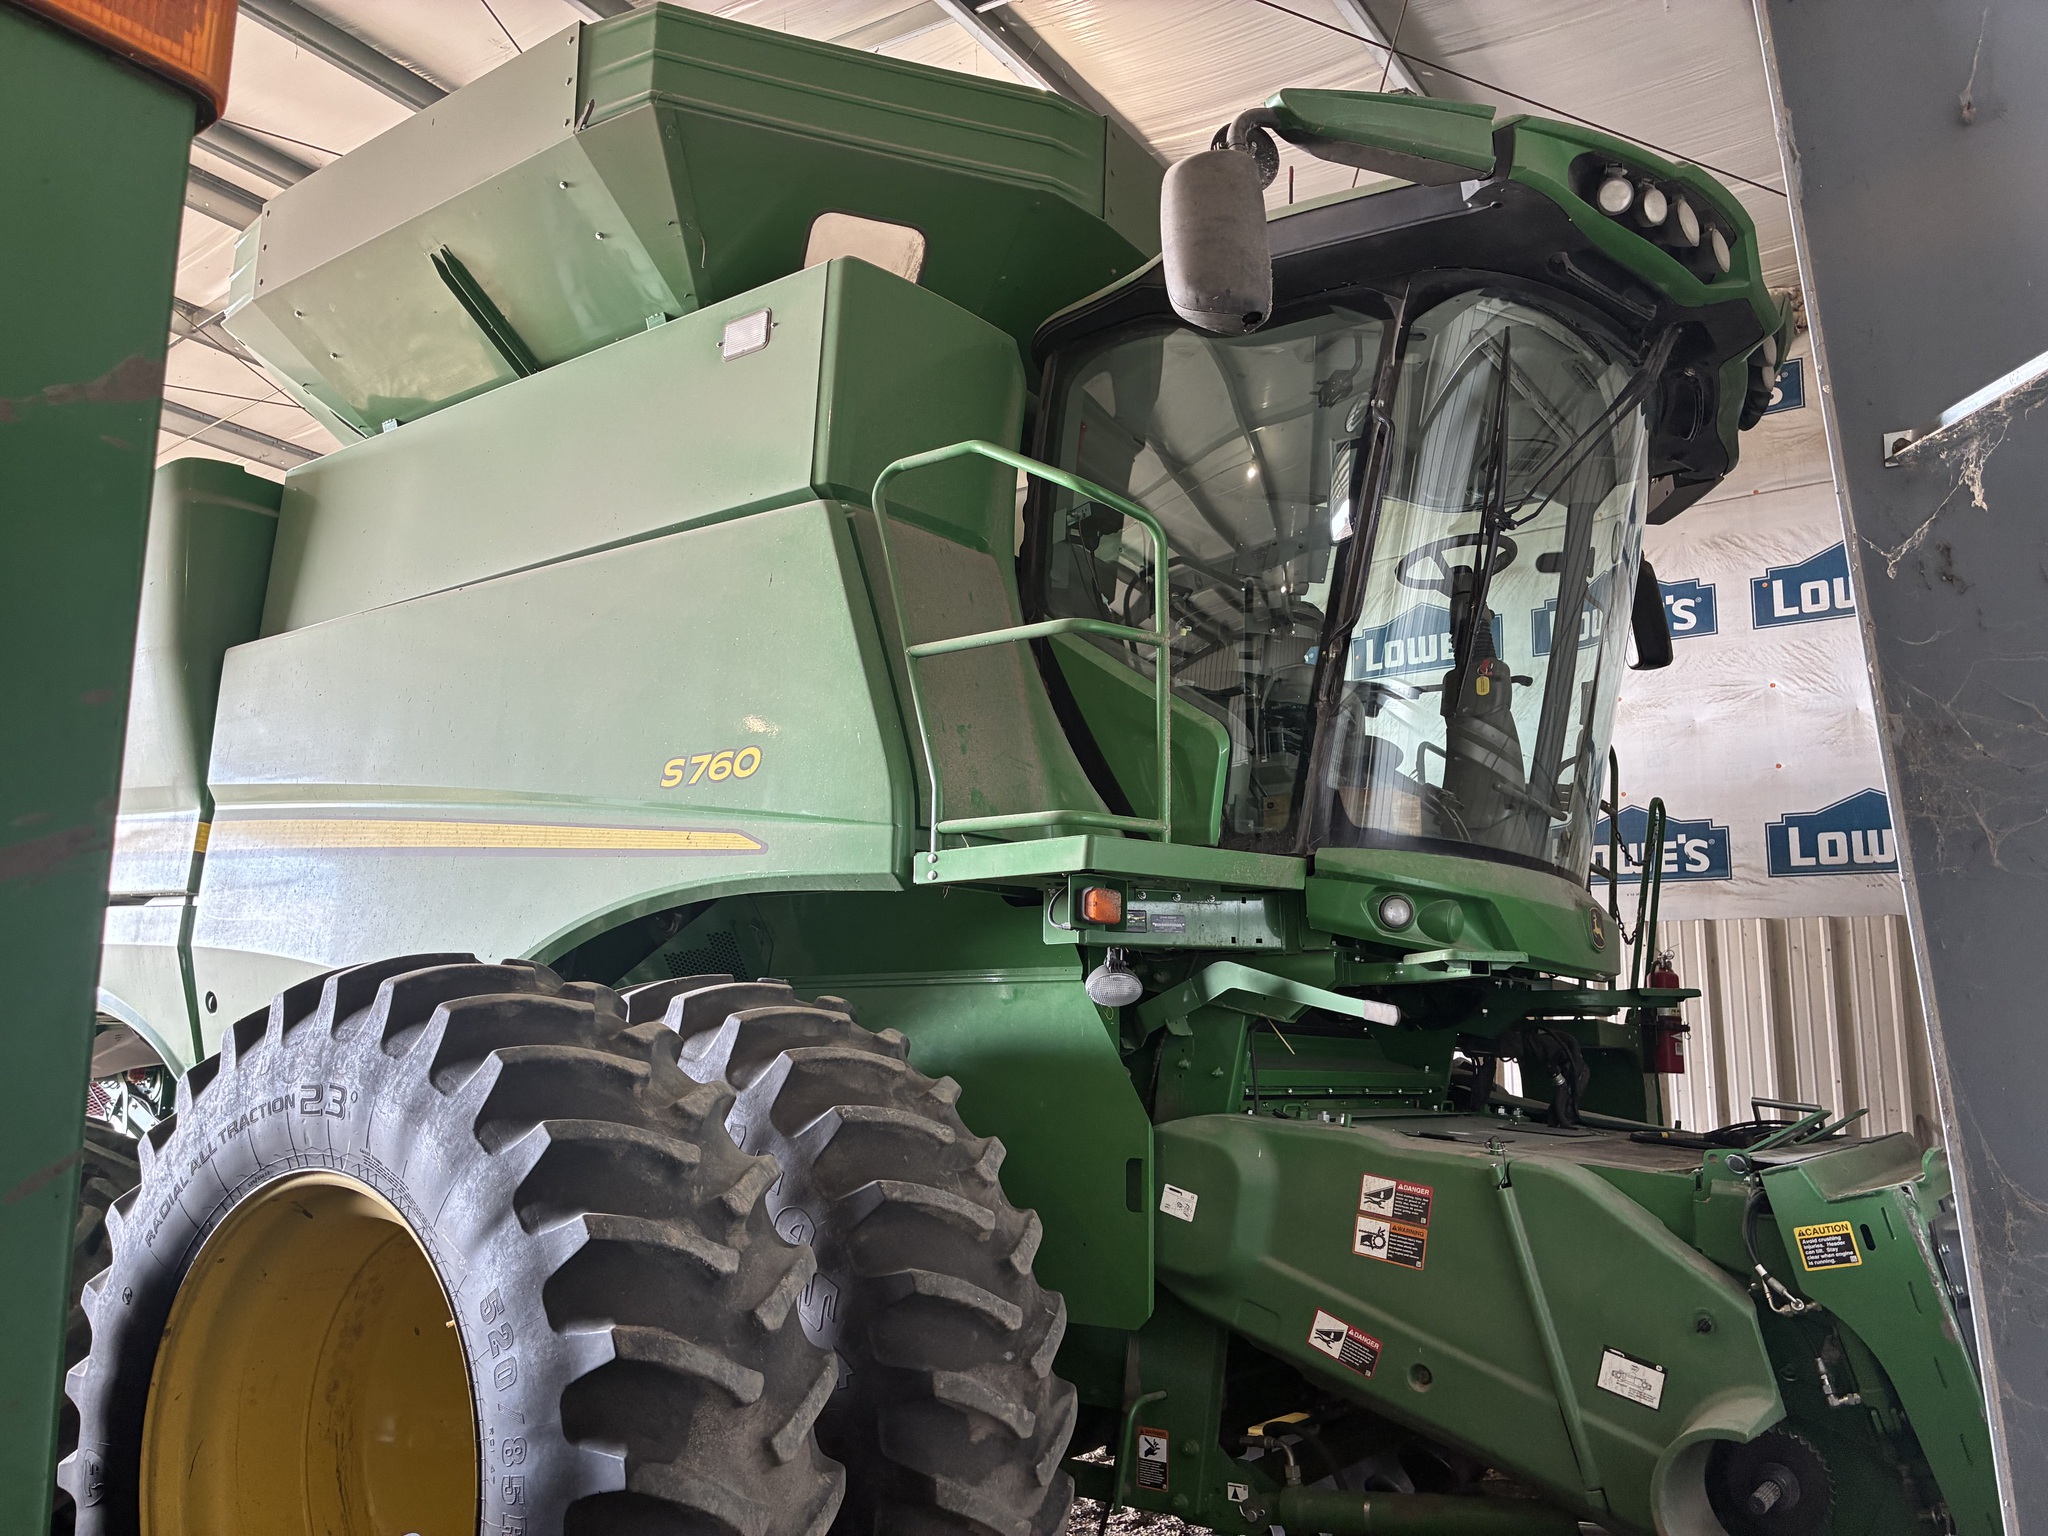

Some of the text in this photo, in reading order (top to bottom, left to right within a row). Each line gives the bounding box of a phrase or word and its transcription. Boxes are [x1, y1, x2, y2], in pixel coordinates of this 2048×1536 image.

[1366, 632, 1456, 672] LOWE
[659, 745, 763, 789] S760
[1788, 827, 1895, 866] LOW
[144, 1176, 190, 1248] RADIAL
[188, 1141, 218, 1175] ALL
[217, 1092, 295, 1145] TRACTION
[1403, 1184, 1430, 1195] DANGER
[1804, 1223, 1849, 1236] CAUTION
[1353, 1331, 1380, 1350] DANGER
